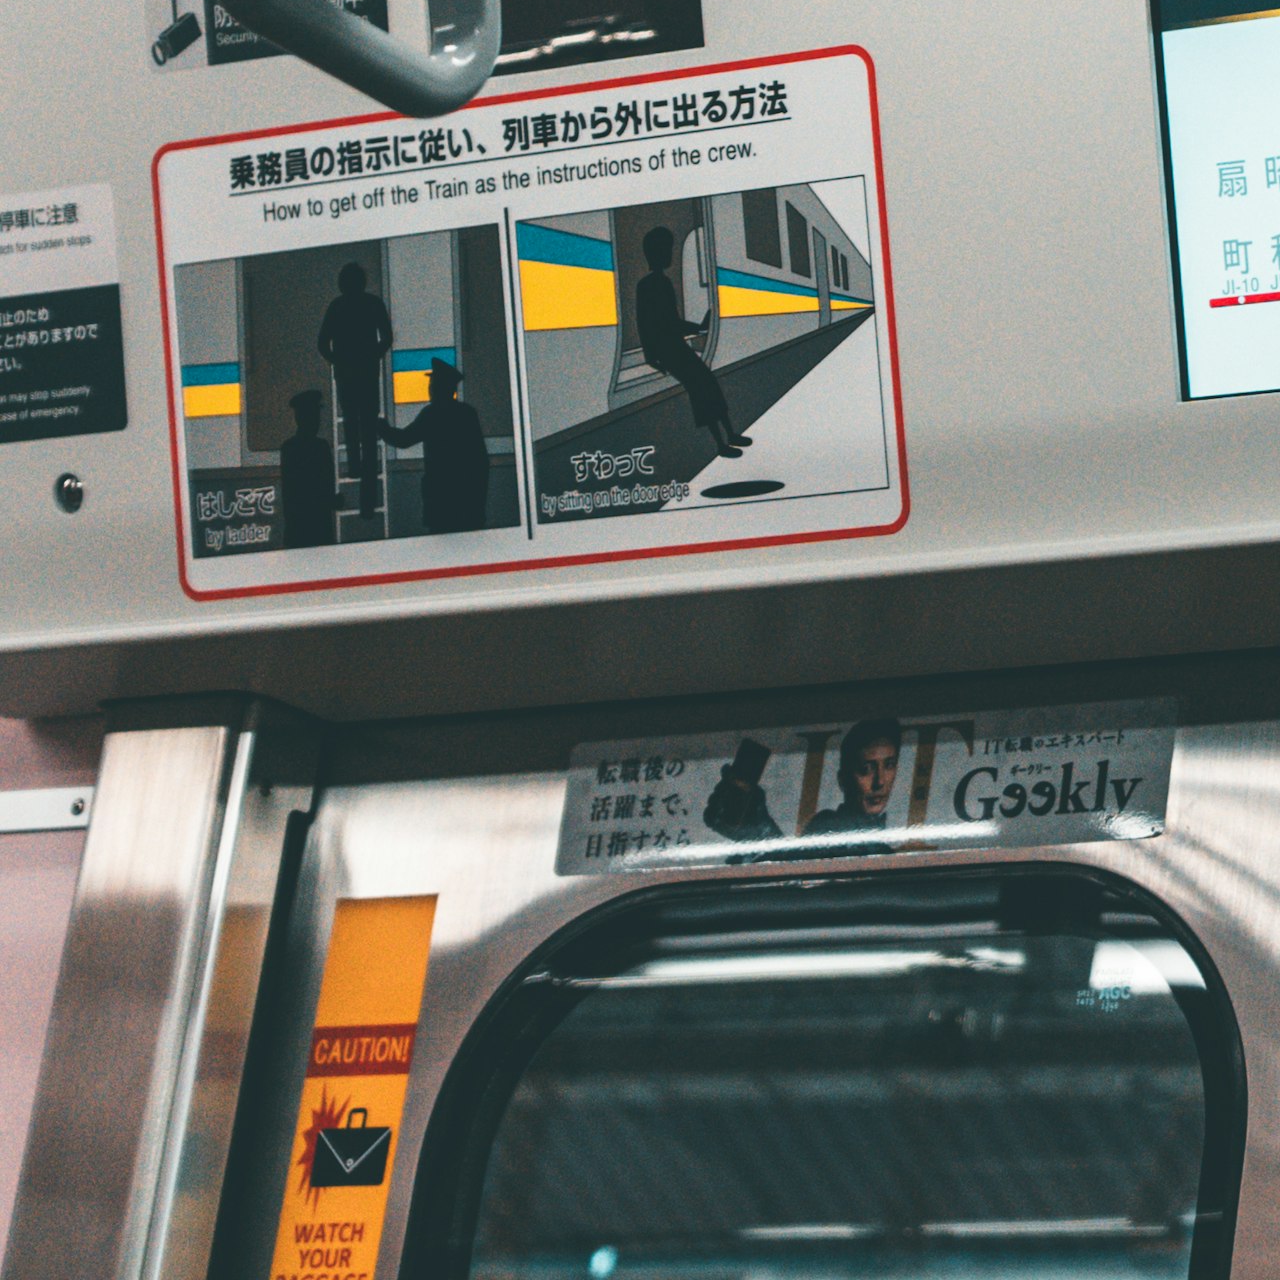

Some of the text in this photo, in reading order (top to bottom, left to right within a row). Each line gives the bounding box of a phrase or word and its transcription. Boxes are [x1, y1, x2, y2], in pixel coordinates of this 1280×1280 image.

[216, 30, 262, 47] Security
[229, 79, 789, 192] 乗務員の指示に従い、列車から外に出る方法
[262, 140, 758, 223] How to get off the Train as the instructions of the crew.
[1214, 159, 1254, 277] 扇町
[1222, 276, 1261, 296] JI-10
[570, 445, 656, 483] すわって
[196, 485, 276, 521] はしごで
[540, 479, 691, 518] by sitting on the door edge
[205, 522, 272, 552] by ladder
[314, 1035, 411, 1065] CAUTION!
[294, 1222, 366, 1245] WATCH
[299, 1247, 353, 1270] YOUR
